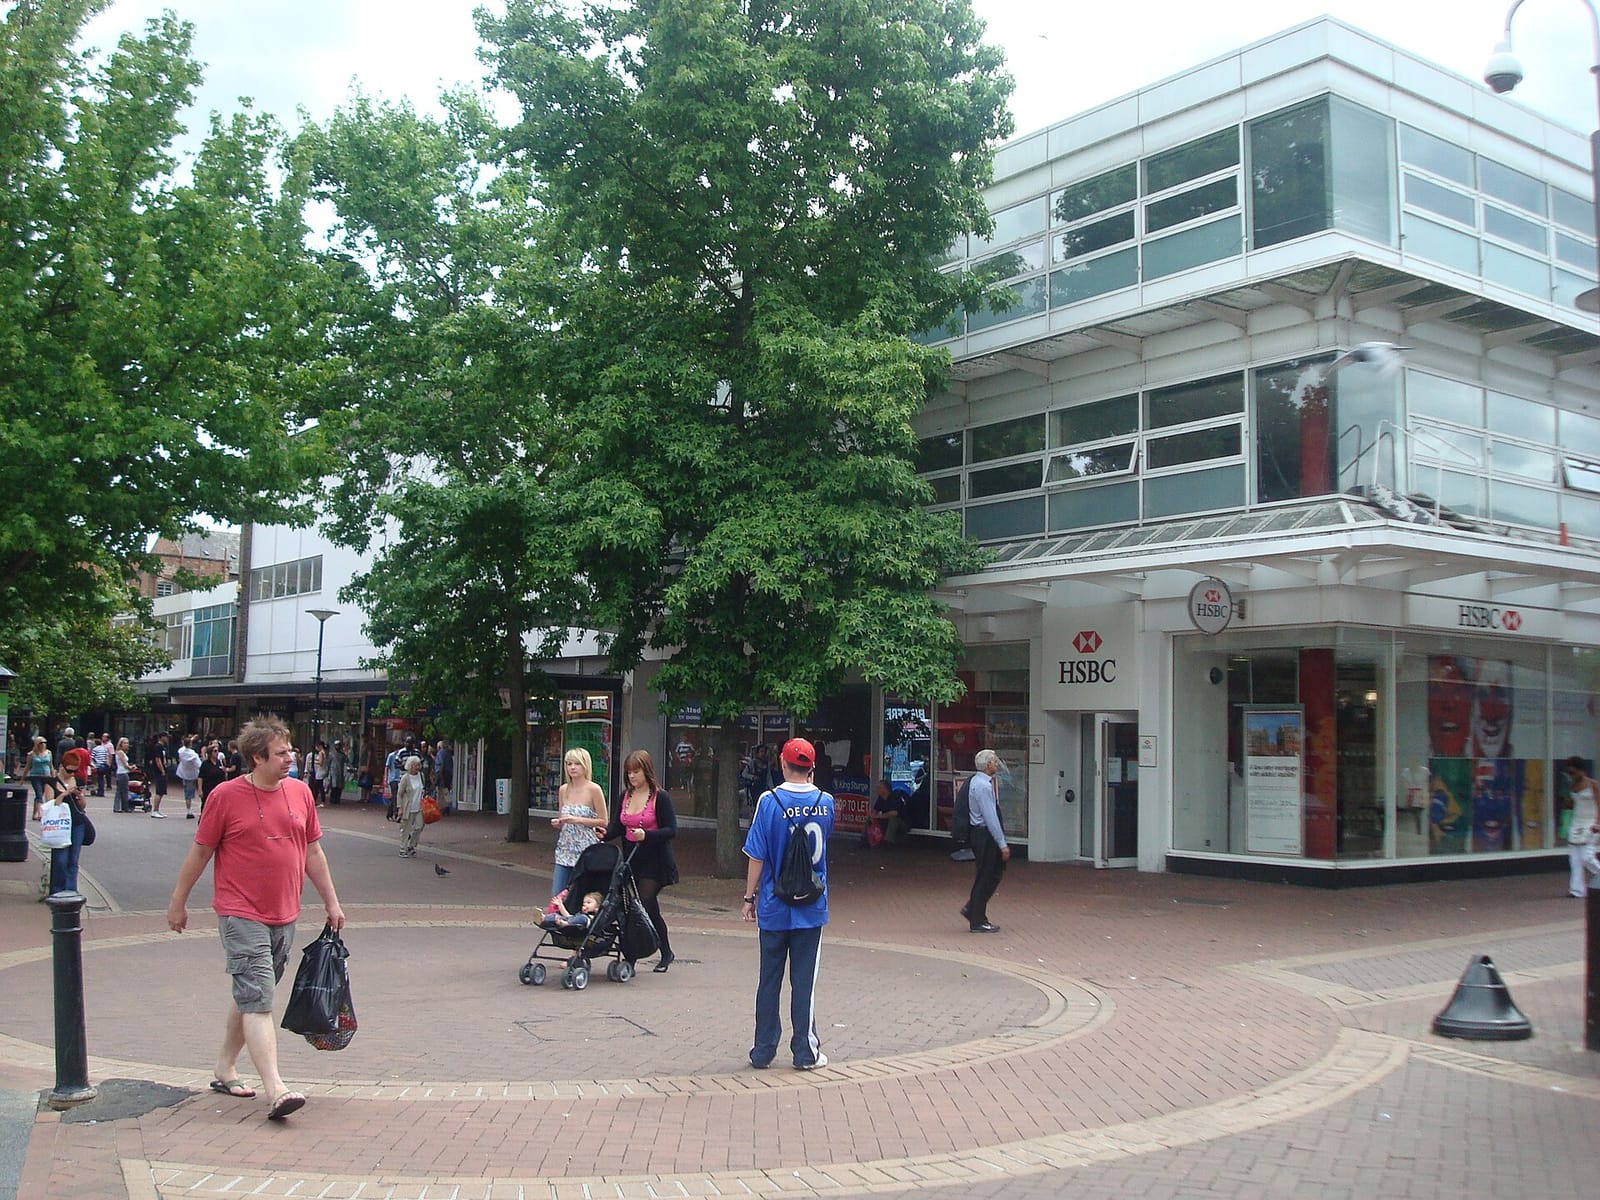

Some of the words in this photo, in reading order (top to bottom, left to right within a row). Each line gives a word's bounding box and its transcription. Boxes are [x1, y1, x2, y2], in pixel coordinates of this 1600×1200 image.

[1196, 603, 1228, 618] HSBC
[1458, 605, 1500, 629] HSBC
[1058, 659, 1116, 684] HSBC
[782, 806, 800, 818] JOE
[802, 805, 828, 816] COLE
[835, 799, 847, 810] HOP
[847, 800, 856, 812] TO
[857, 801, 869, 813] LET
